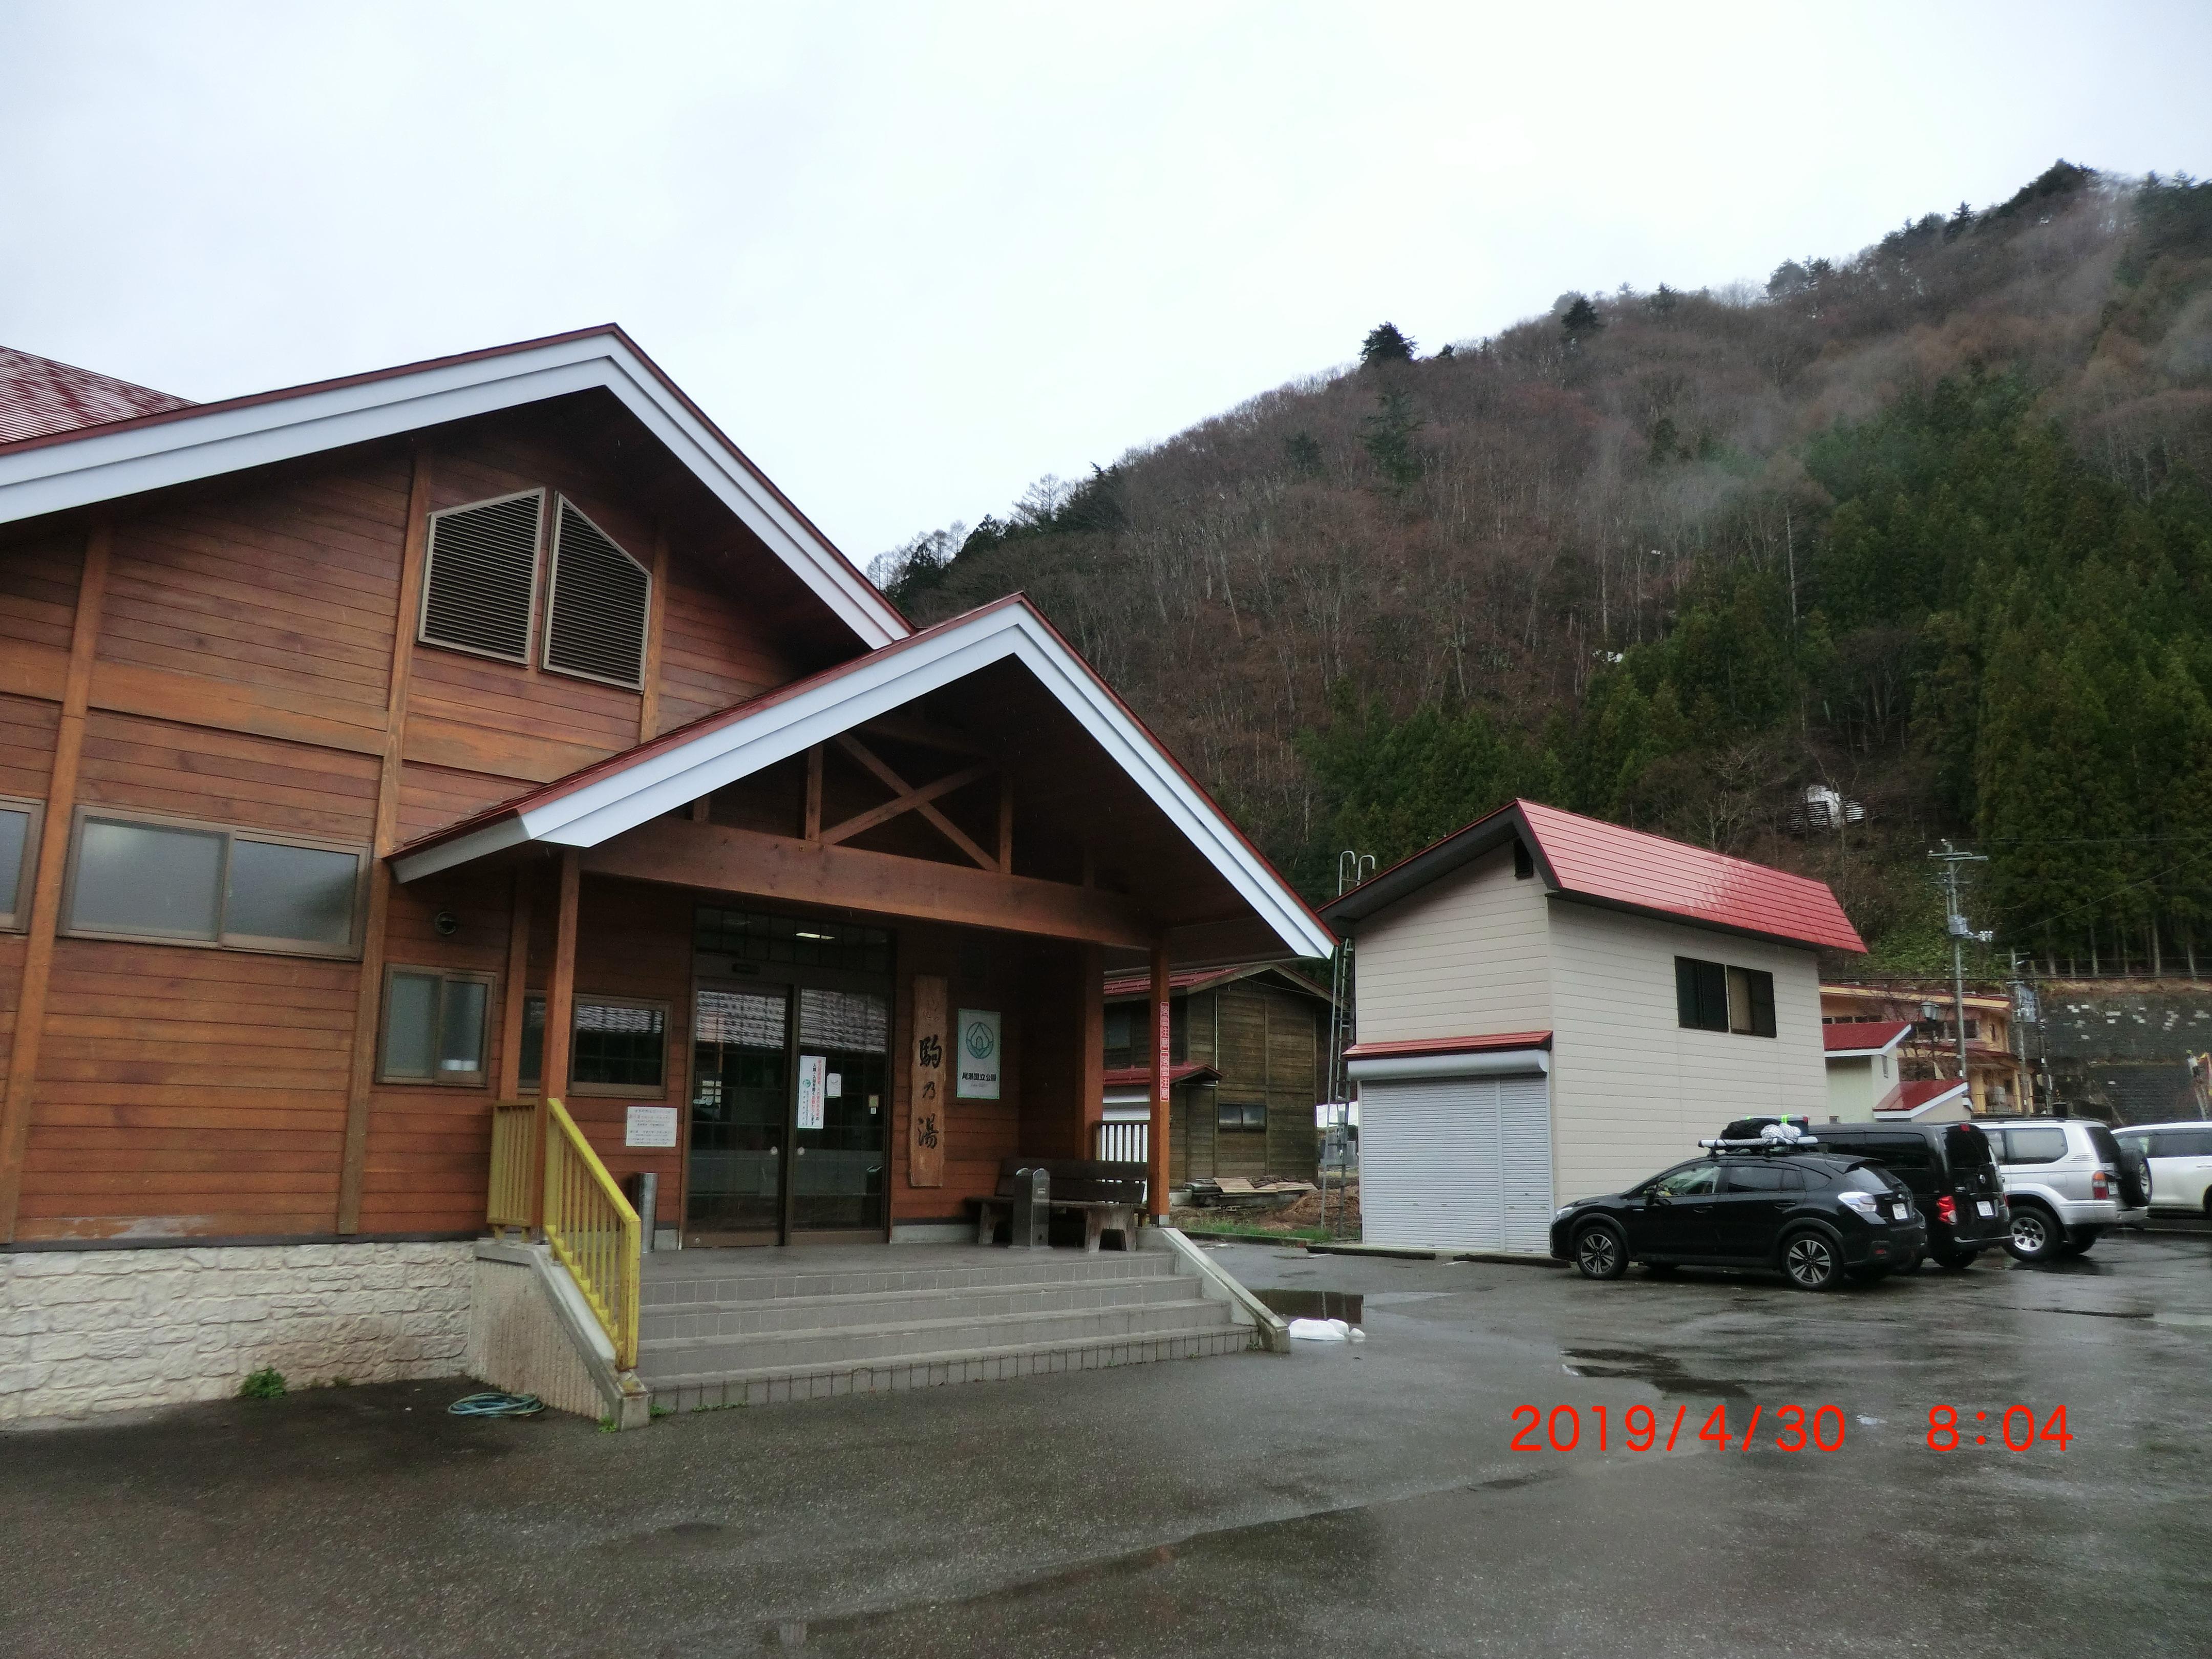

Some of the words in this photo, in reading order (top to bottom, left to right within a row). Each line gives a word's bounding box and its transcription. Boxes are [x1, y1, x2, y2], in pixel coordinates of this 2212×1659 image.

[962, 1072, 997, 1081] 尾瀬国立公園
